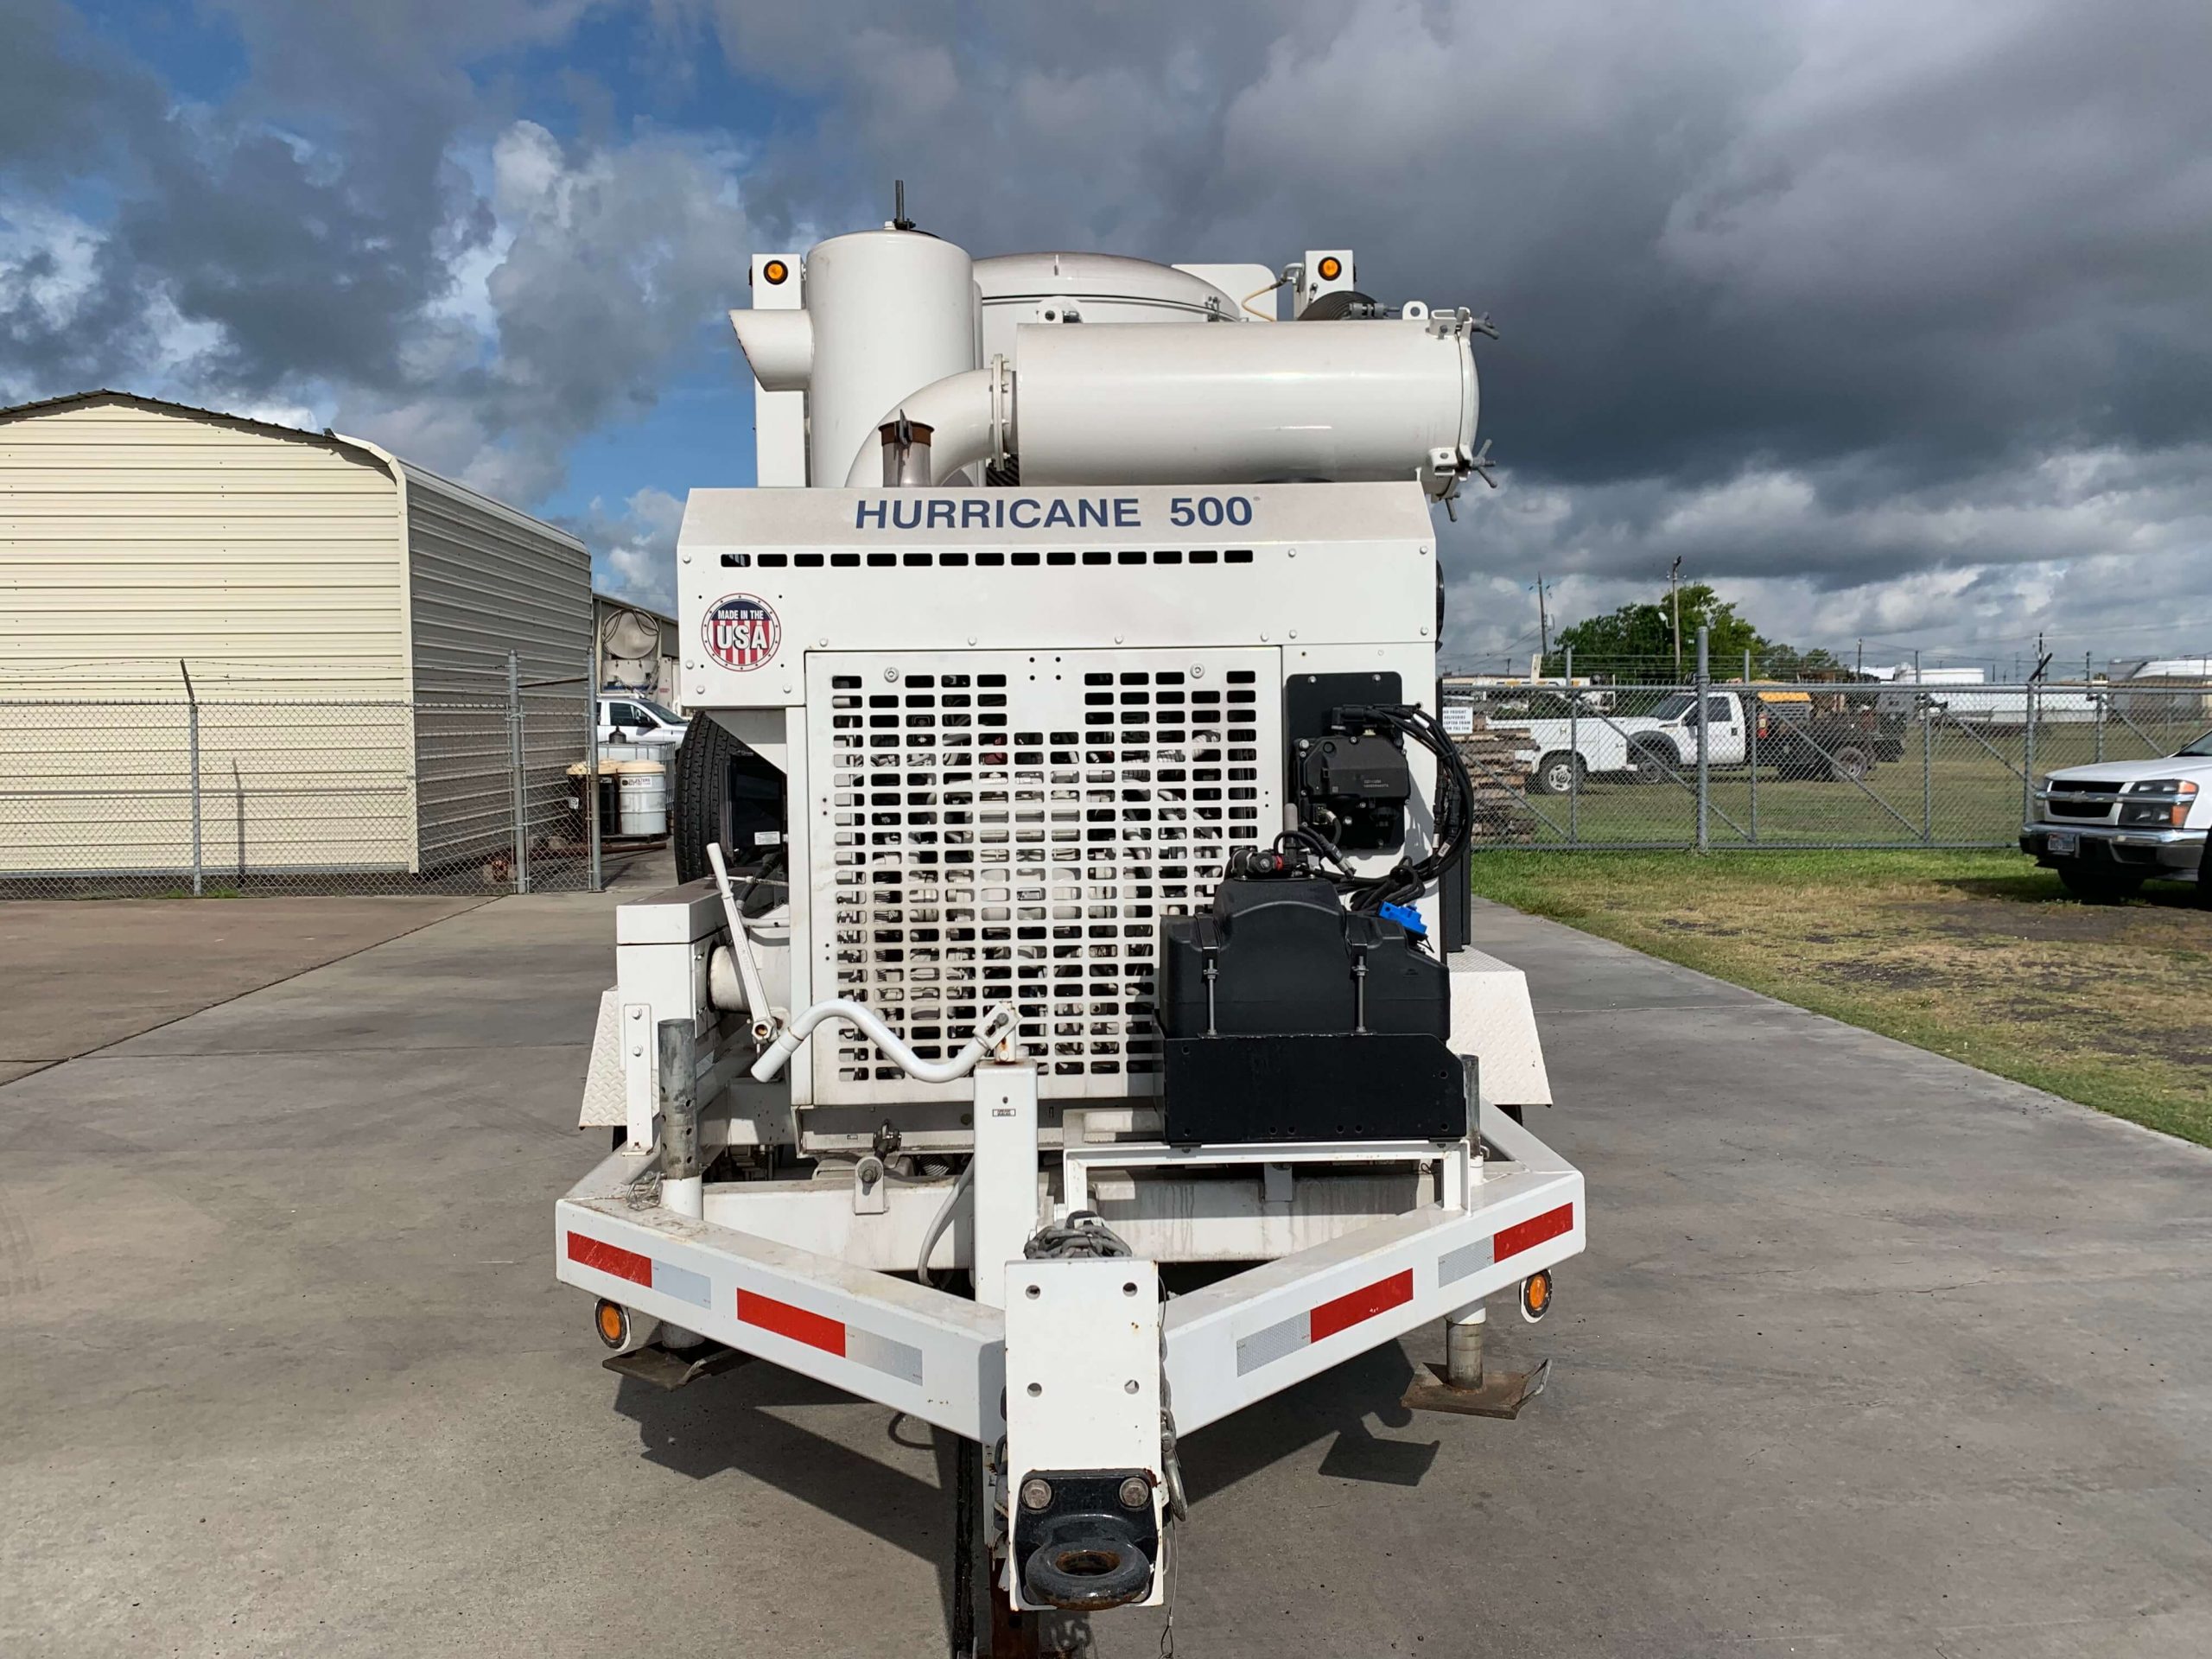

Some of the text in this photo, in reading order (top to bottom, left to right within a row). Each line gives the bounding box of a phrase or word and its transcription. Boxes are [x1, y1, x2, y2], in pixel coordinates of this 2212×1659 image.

[855, 496, 1253, 529] HURRICANE 500
[718, 610, 764, 620] MADE IN THE
[716, 625, 768, 650] USA
